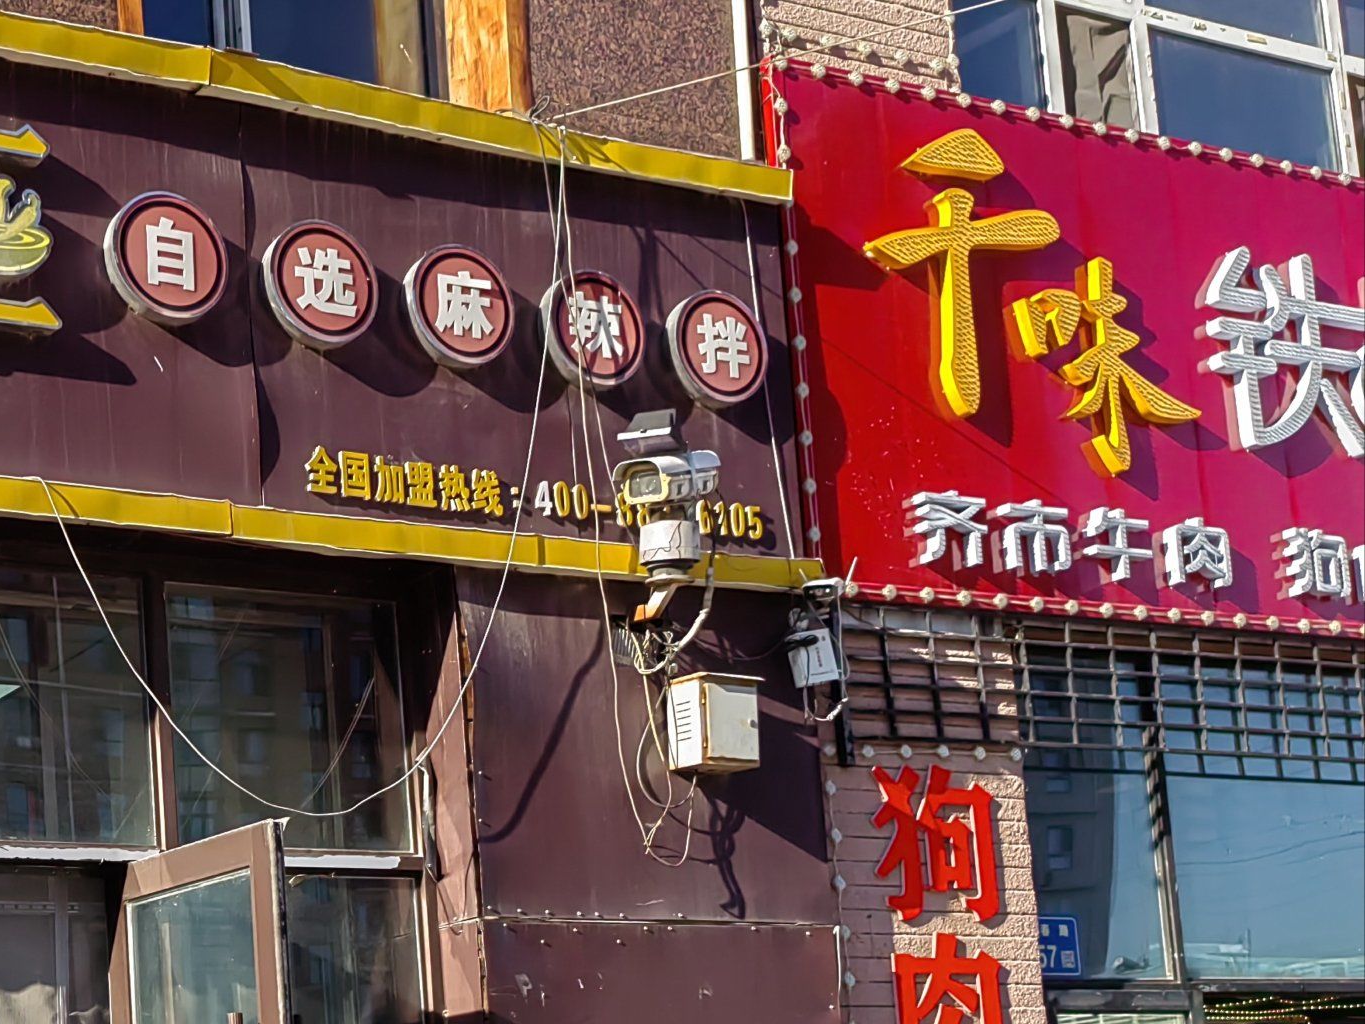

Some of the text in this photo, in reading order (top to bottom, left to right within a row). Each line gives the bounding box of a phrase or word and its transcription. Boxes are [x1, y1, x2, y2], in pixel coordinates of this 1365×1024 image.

[143, 215, 752, 380] 自选麻辣拌
[863, 129, 1365, 476] 千味铁
[910, 491, 1365, 604] 齐市牛肉 狗
